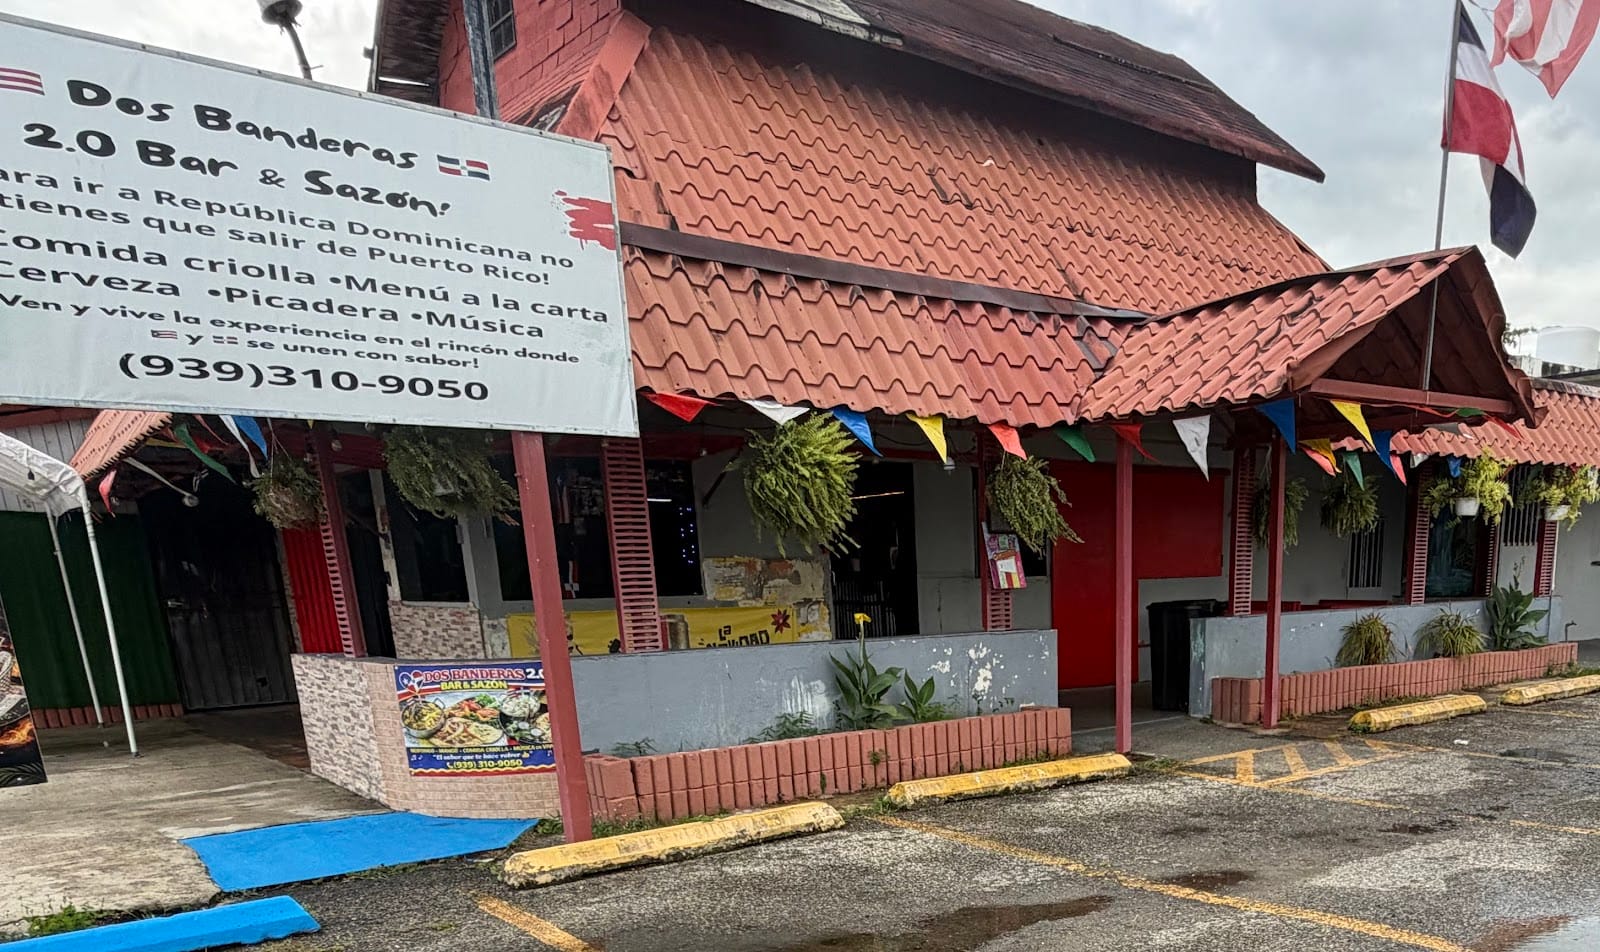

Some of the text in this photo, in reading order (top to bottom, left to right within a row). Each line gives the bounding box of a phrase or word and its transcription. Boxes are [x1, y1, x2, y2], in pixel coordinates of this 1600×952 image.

[66, 79, 418, 169] Dos Banderas
[23, 122, 451, 218] 2.0 Bar & Sazón!
[0, 193, 550, 284] tienes que salir de Puerto Rico!
[73, 176, 104, 195] ir
[118, 187, 140, 202] a
[153, 190, 336, 232] República
[347, 221, 532, 262] Dominicana
[541, 254, 574, 268] no
[183, 257, 315, 286] criolla
[461, 293, 480, 306] a
[492, 293, 520, 311] la
[530, 303, 608, 323] carta
[0, 293, 580, 363] Ven y vive la experiencia en el rincón donde
[185, 334, 479, 368] y se unen con sabor!
[118, 352, 489, 401] (939)310-9050
[423, 670, 450, 683] DOS
[451, 668, 526, 681] BANDERAS
[440, 678, 508, 690] BAR & SAZÓN
[453, 758, 523, 770] (939) 310-9050
